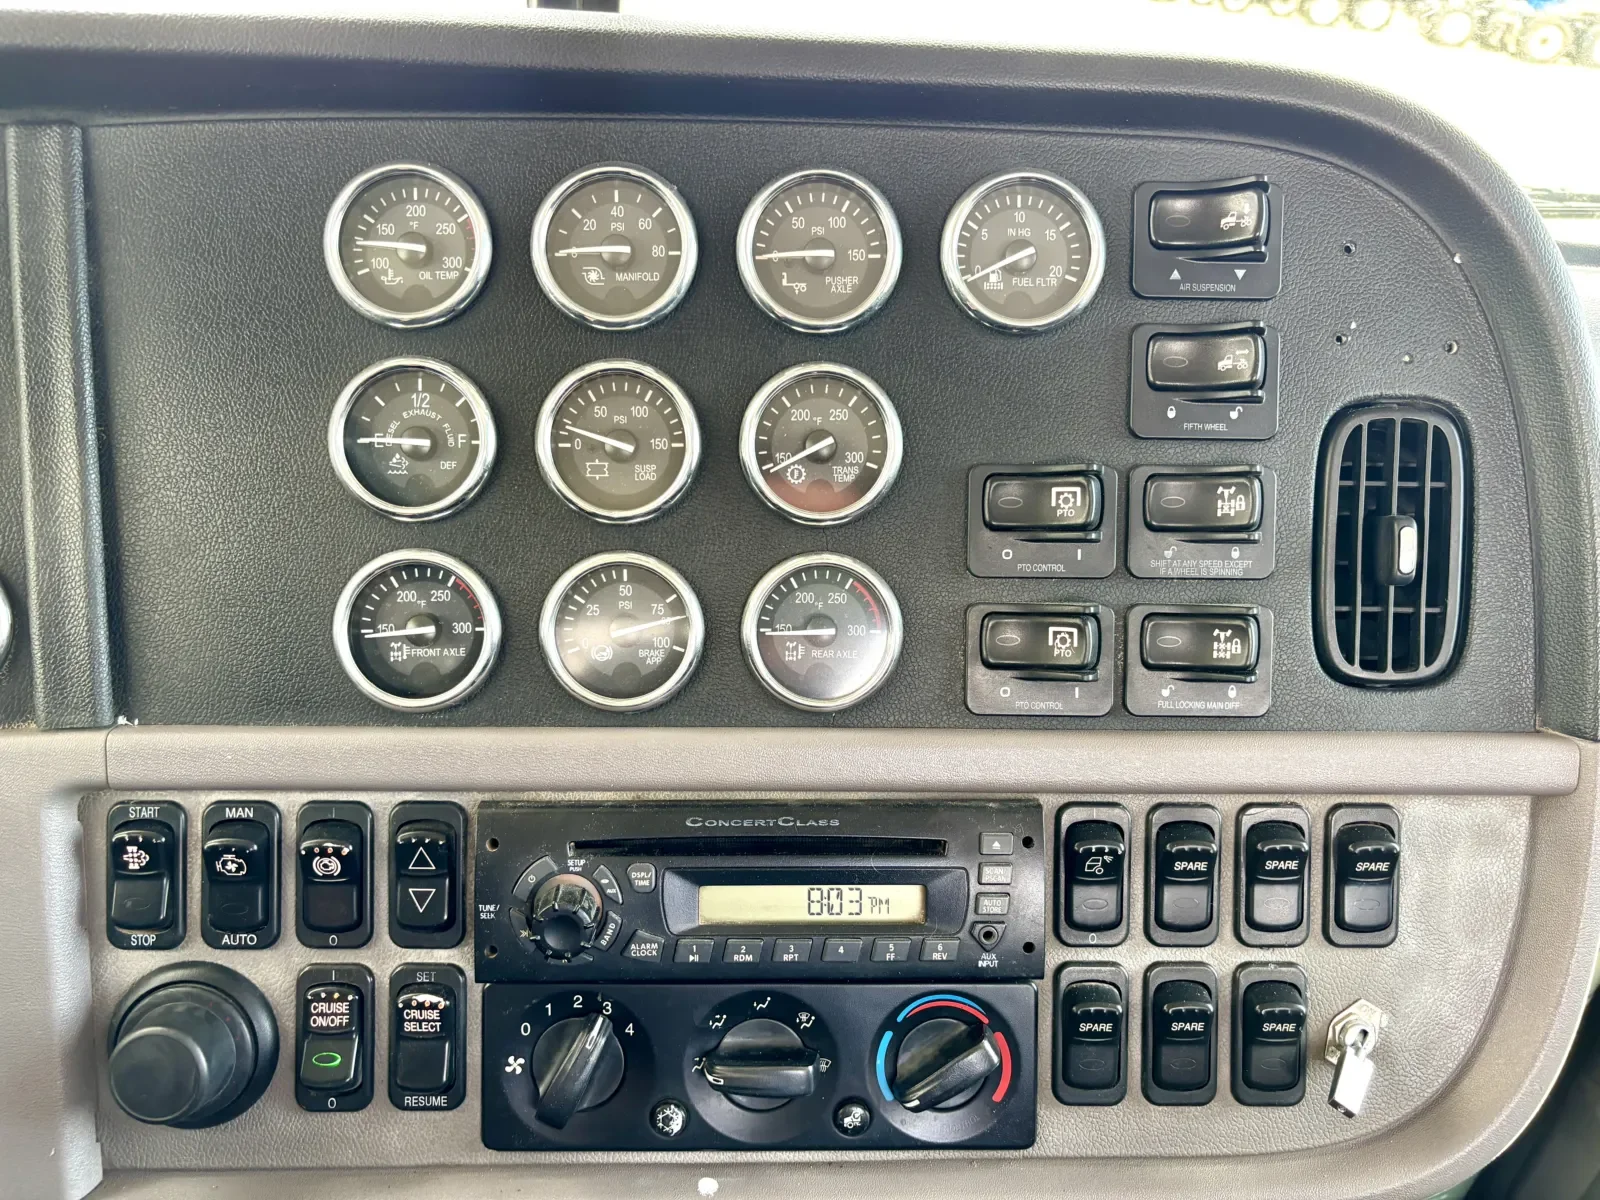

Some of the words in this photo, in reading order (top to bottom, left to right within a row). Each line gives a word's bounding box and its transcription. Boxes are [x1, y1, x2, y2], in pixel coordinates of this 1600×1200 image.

[406, 205, 426, 217] 200
[611, 205, 624, 217] 40
[1014, 211, 1025, 223] 10
[583, 219, 597, 231] 20
[611, 223, 625, 231] PSI
[638, 218, 652, 230] 60
[791, 217, 805, 229] 50
[828, 217, 846, 229] 100
[376, 223, 395, 236] 150
[435, 223, 456, 235] 250
[812, 227, 825, 235] PSI
[981, 229, 988, 240] 5
[1007, 228, 1016, 237] IN
[1018, 228, 1031, 237] HG
[1045, 229, 1056, 241] 15
[652, 245, 665, 257] 80
[848, 249, 866, 261] 150
[370, 257, 389, 270] 100
[442, 257, 462, 269] 300
[419, 271, 433, 280] OIL
[435, 271, 459, 280] TEMP
[615, 272, 660, 281] MANIFOLD
[1049, 266, 1062, 277] 20
[825, 276, 859, 285] PUSHER
[1012, 278, 1034, 287] FUEL
[1036, 278, 1057, 287] FLTR
[830, 284, 852, 293] AXLE
[1179, 283, 1190, 291] AIR
[1192, 283, 1236, 292] SUSPENSION
[411, 393, 430, 408] 1/2
[594, 406, 607, 417] 50
[631, 406, 649, 417] 100
[791, 409, 810, 421] 200
[829, 409, 848, 421] 250
[614, 416, 628, 424] PSI
[402, 408, 443, 421] EXHAUST
[442, 423, 455, 447] FLUID
[1184, 423, 1203, 431] FIFTH
[1204, 423, 1228, 431] WHEEL
[458, 434, 466, 448] F
[575, 439, 582, 450] 0
[650, 438, 668, 450] 150
[845, 451, 864, 463] 300
[440, 461, 457, 470] DEF
[634, 465, 657, 473] SUSP
[832, 466, 859, 474] TRANS
[634, 472, 657, 481] LOAD
[833, 474, 855, 482] TEMP
[1017, 564, 1031, 572] PTO
[1033, 564, 1066, 572] CONTROL
[1151, 560, 1171, 568] SHIFT
[1182, 560, 1197, 568] ANY
[1199, 560, 1223, 568] SPEED
[1225, 560, 1253, 568] EXCEPT
[1210, 568, 1244, 576] SPINNING
[397, 590, 416, 602] 200
[431, 590, 450, 602] 250
[619, 585, 633, 596] 50
[795, 592, 814, 604] 200
[828, 593, 847, 604] 250
[586, 604, 600, 616] 25
[619, 601, 633, 610] PSI
[651, 604, 664, 615] 75
[452, 622, 472, 634] 300
[847, 625, 866, 636] 300
[582, 638, 588, 649] 0
[652, 637, 670, 648] 100
[411, 648, 440, 657] FRONT
[443, 647, 466, 657] AXLE
[639, 649, 665, 657] BRAKE
[811, 650, 834, 659] REAR
[836, 650, 858, 659] AXLE
[646, 657, 662, 665] APP
[1031, 702, 1063, 710] CONTROL
[1158, 701, 1174, 709] FULL
[1175, 701, 1205, 710] LOCKING
[1207, 701, 1223, 709] MAIN
[1225, 702, 1240, 710] DIFF
[129, 807, 160, 818] START
[225, 808, 254, 818] MAN
[1174, 861, 1208, 871] SPARE
[1265, 860, 1299, 870] SPARE
[1355, 862, 1390, 872] SPARE
[808, 887, 862, 916] 8:03
[868, 897, 890, 914] PM
[131, 934, 156, 946] STOP
[222, 934, 257, 945] AUTO
[600, 923, 616, 946] BAND
[938, 943, 942, 951] 6
[733, 954, 753, 962] RDM
[886, 953, 895, 961] FF
[417, 972, 437, 982] SET
[573, 995, 583, 1008] 2
[311, 1002, 350, 1013] CRUISE
[545, 1003, 552, 1016] 1
[602, 1002, 612, 1014] 3
[404, 1009, 440, 1020] CRUISE
[310, 1016, 350, 1027] ON/OFF
[404, 1022, 442, 1032] SELECT
[1171, 1022, 1205, 1031] SPARE
[521, 1022, 531, 1036] 0
[625, 1023, 634, 1036] 4
[1079, 1023, 1113, 1032] SPARE
[1262, 1023, 1296, 1032] SPARE
[404, 1096, 448, 1107] RESUME
